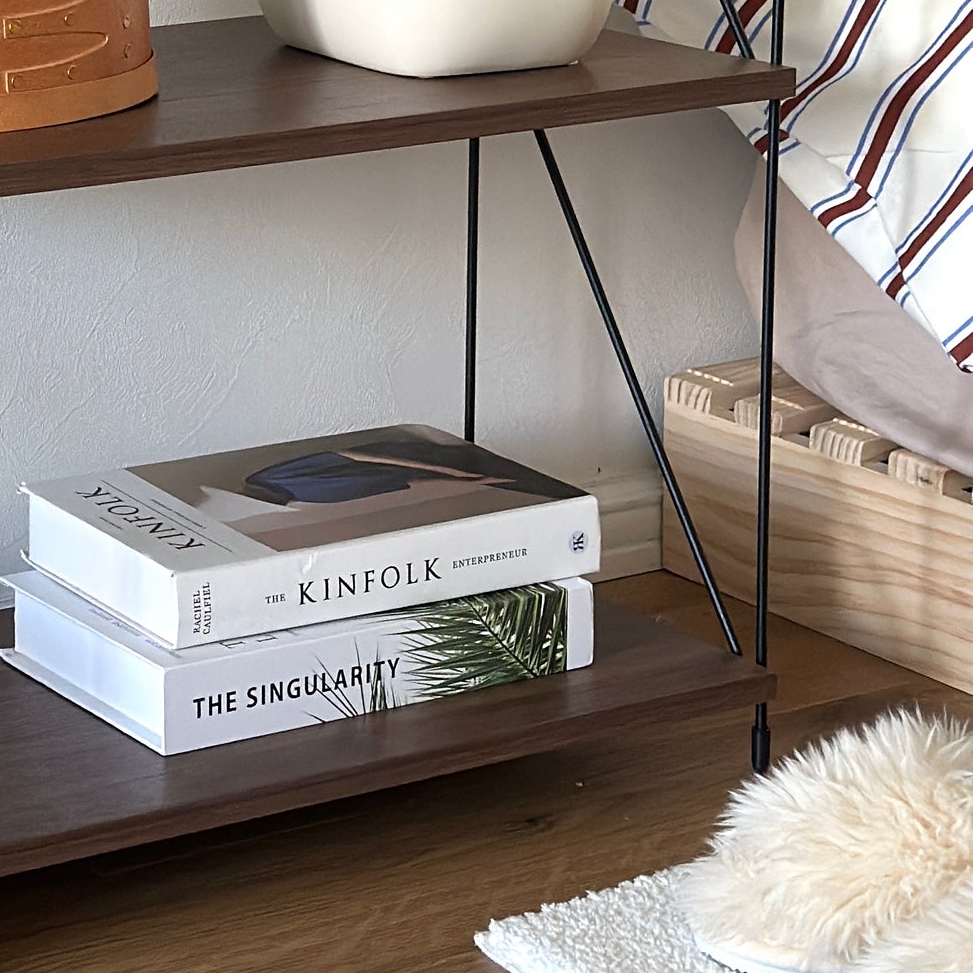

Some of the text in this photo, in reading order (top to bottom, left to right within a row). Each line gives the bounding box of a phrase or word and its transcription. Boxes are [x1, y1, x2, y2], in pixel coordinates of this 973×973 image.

[75, 486, 206, 550] KINFOLK
[265, 548, 528, 605] THE KINFOLK ENTERPRENEUR
[192, 589, 202, 634] RACHEL
[202, 581, 212, 635] CAULFIEL
[192, 657, 400, 719] THE SINGULARITY
